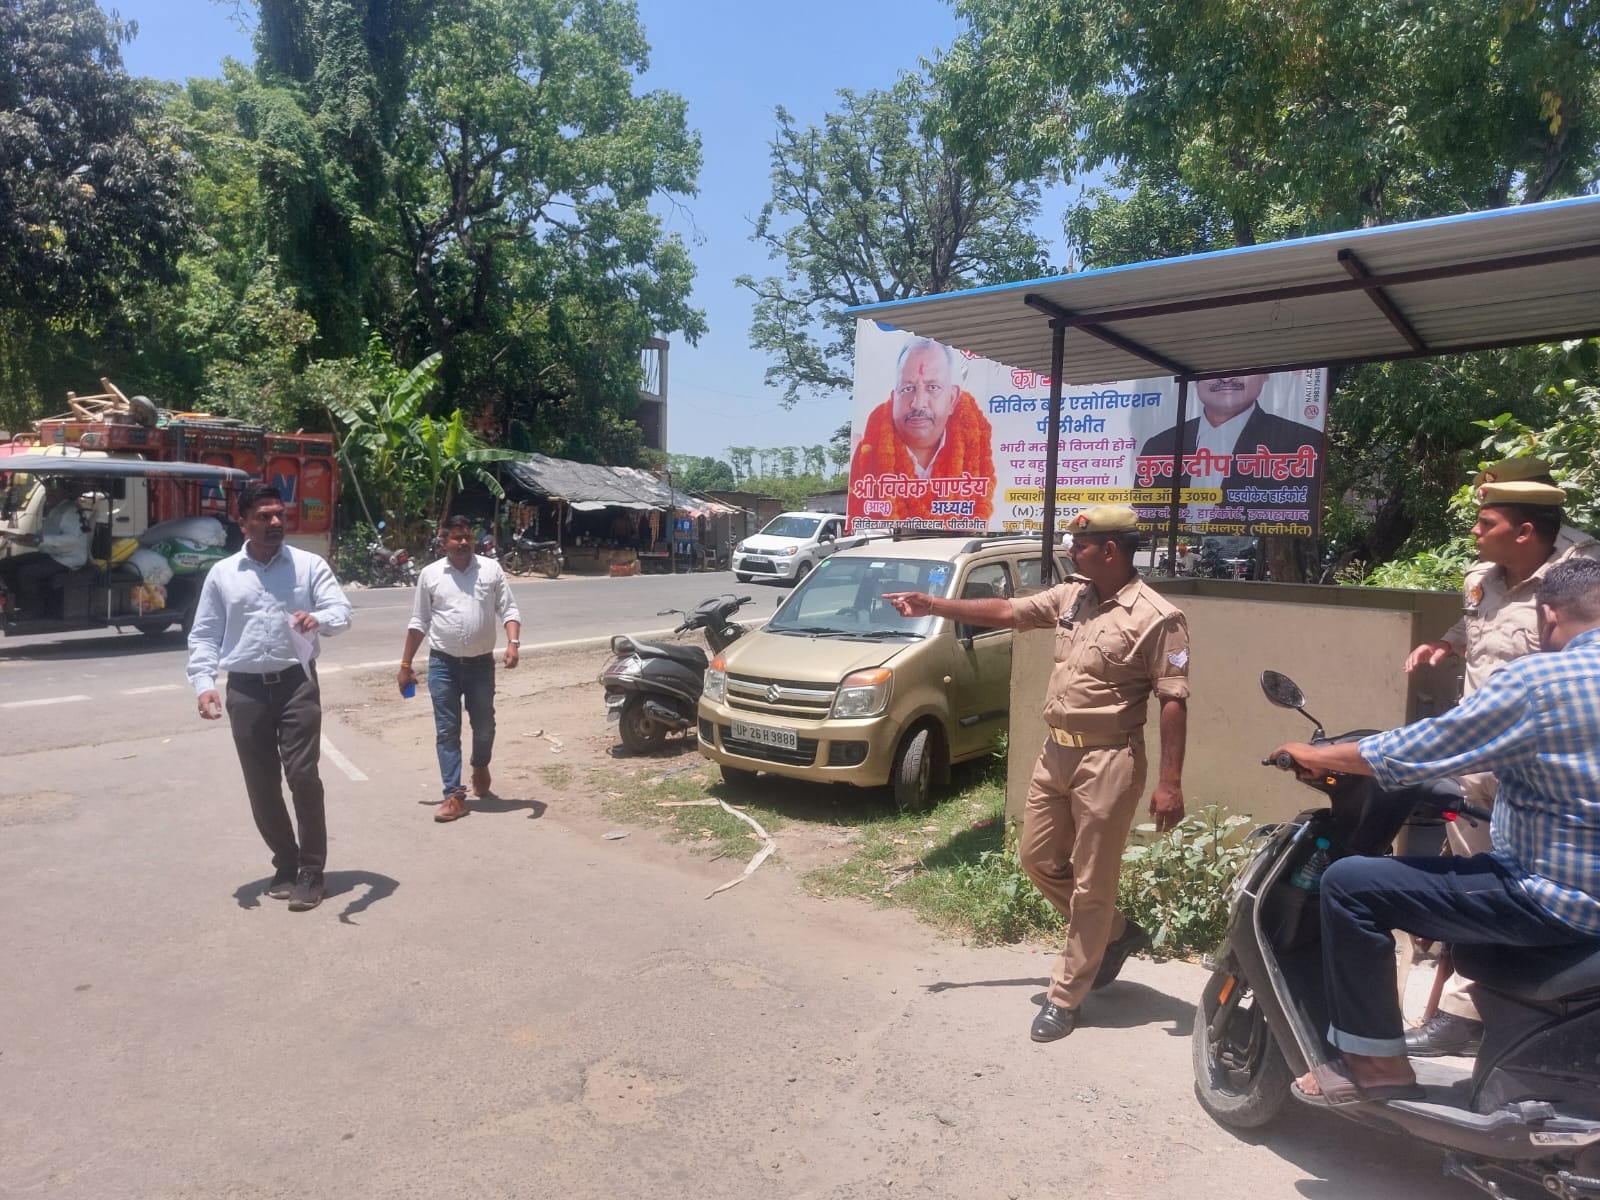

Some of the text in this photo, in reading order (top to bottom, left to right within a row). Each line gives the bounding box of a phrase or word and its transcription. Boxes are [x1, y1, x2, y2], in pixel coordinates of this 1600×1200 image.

[989, 390, 1162, 414] सिविल बर एसोसिएशन
[1001, 439, 1026, 453] भारी
[1070, 438, 1110, 451] विजयी
[1112, 439, 1137, 451] होने
[1010, 459, 1025, 470] पर
[1091, 455, 1126, 469] बधाई
[1236, 444, 1317, 481] जौहरी
[853, 472, 989, 498] श्री विवेक पाण्डेय
[1014, 474, 1032, 486] एवं
[1088, 492, 1105, 502] बार
[1269, 485, 1308, 503] हाईकोर्ट
[931, 500, 975, 516] अध्यक्ष
[947, 517, 987, 529] पीलीभीत
[1250, 522, 1313, 537] (पीलीभीत)
[736, 723, 748, 737] UP
[750, 727, 761, 740] 26
[763, 729, 769, 742] H
